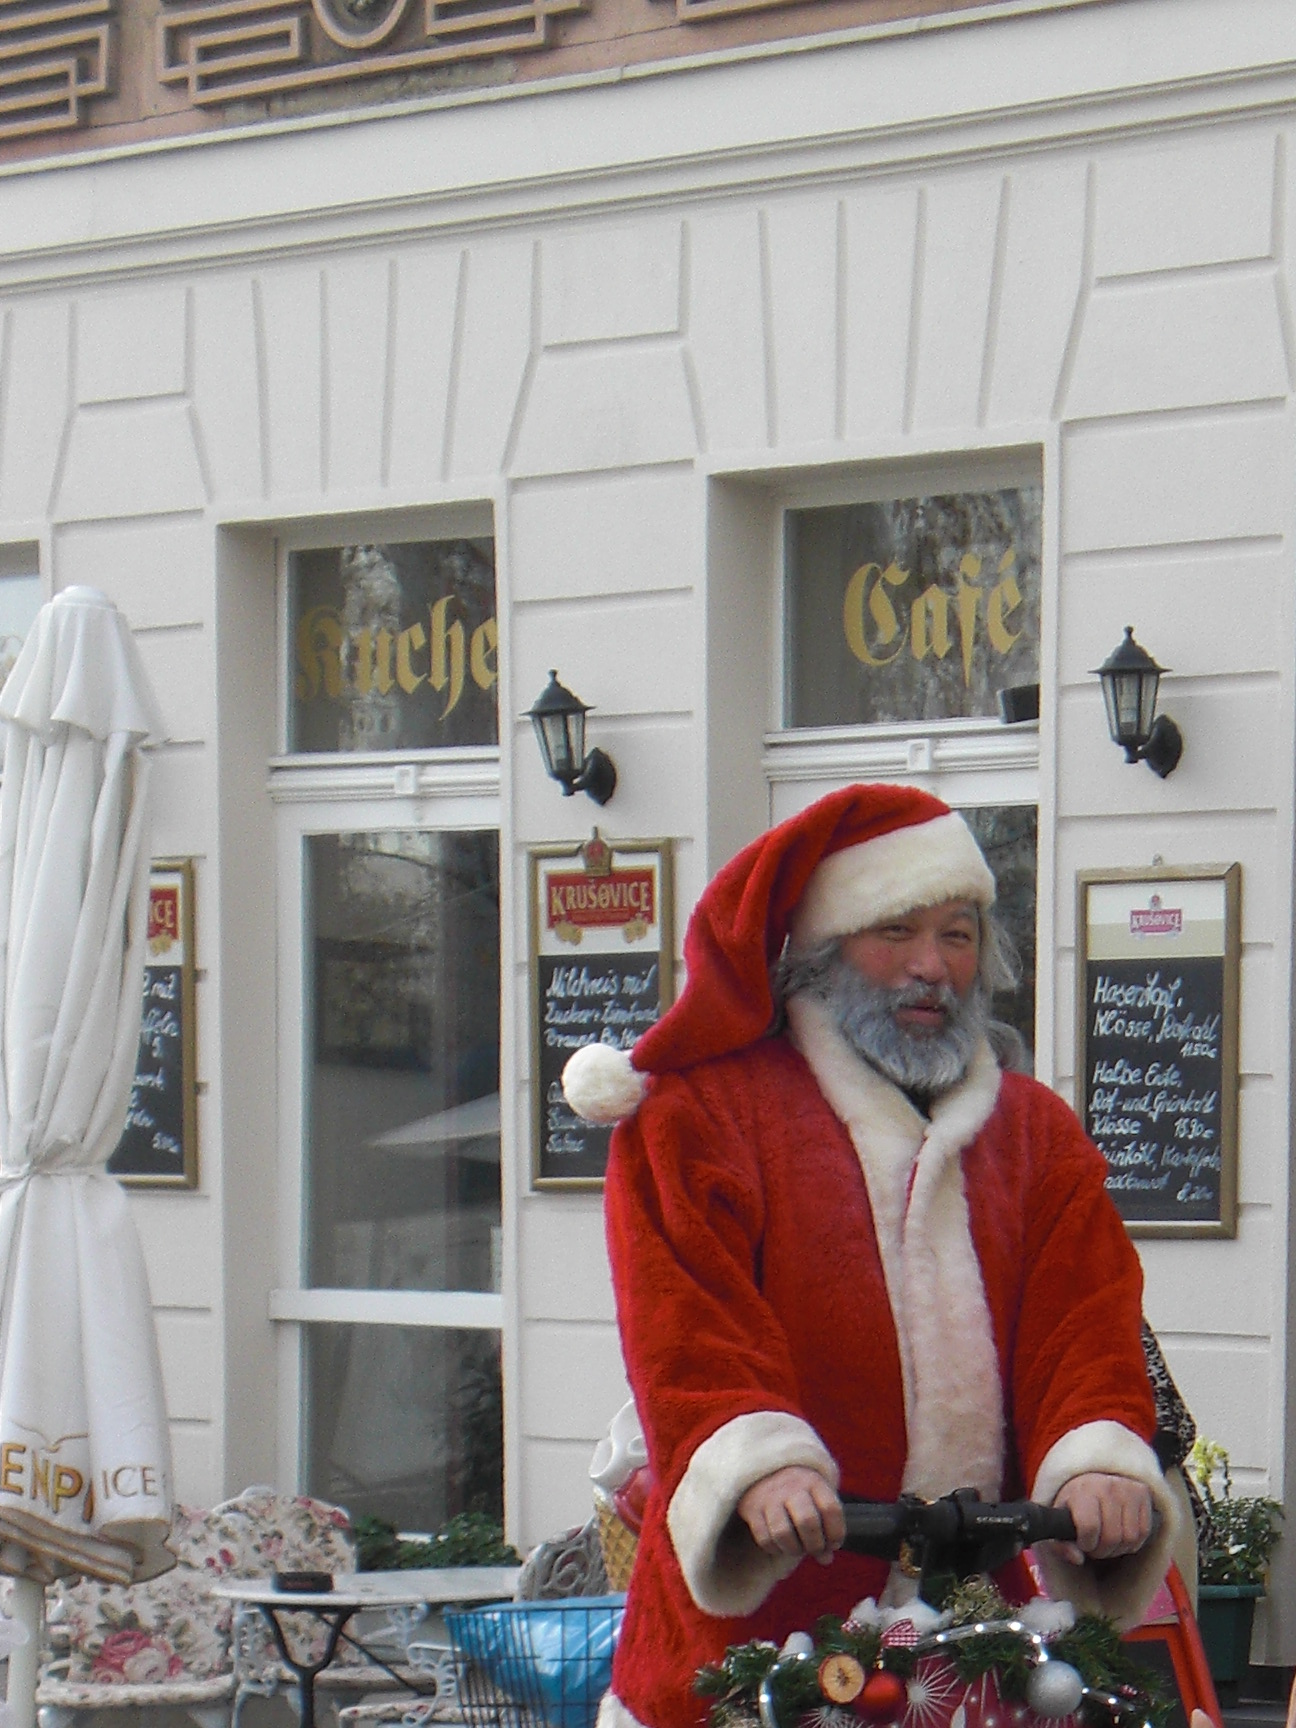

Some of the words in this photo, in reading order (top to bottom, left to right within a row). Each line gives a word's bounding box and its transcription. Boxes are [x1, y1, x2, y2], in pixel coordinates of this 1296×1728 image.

[843, 548, 1024, 688] Café
[550, 878, 650, 916] KRUŠOVICE
[1092, 1058, 1143, 1085] Halbe
[102, 1466, 158, 1500] ICE
